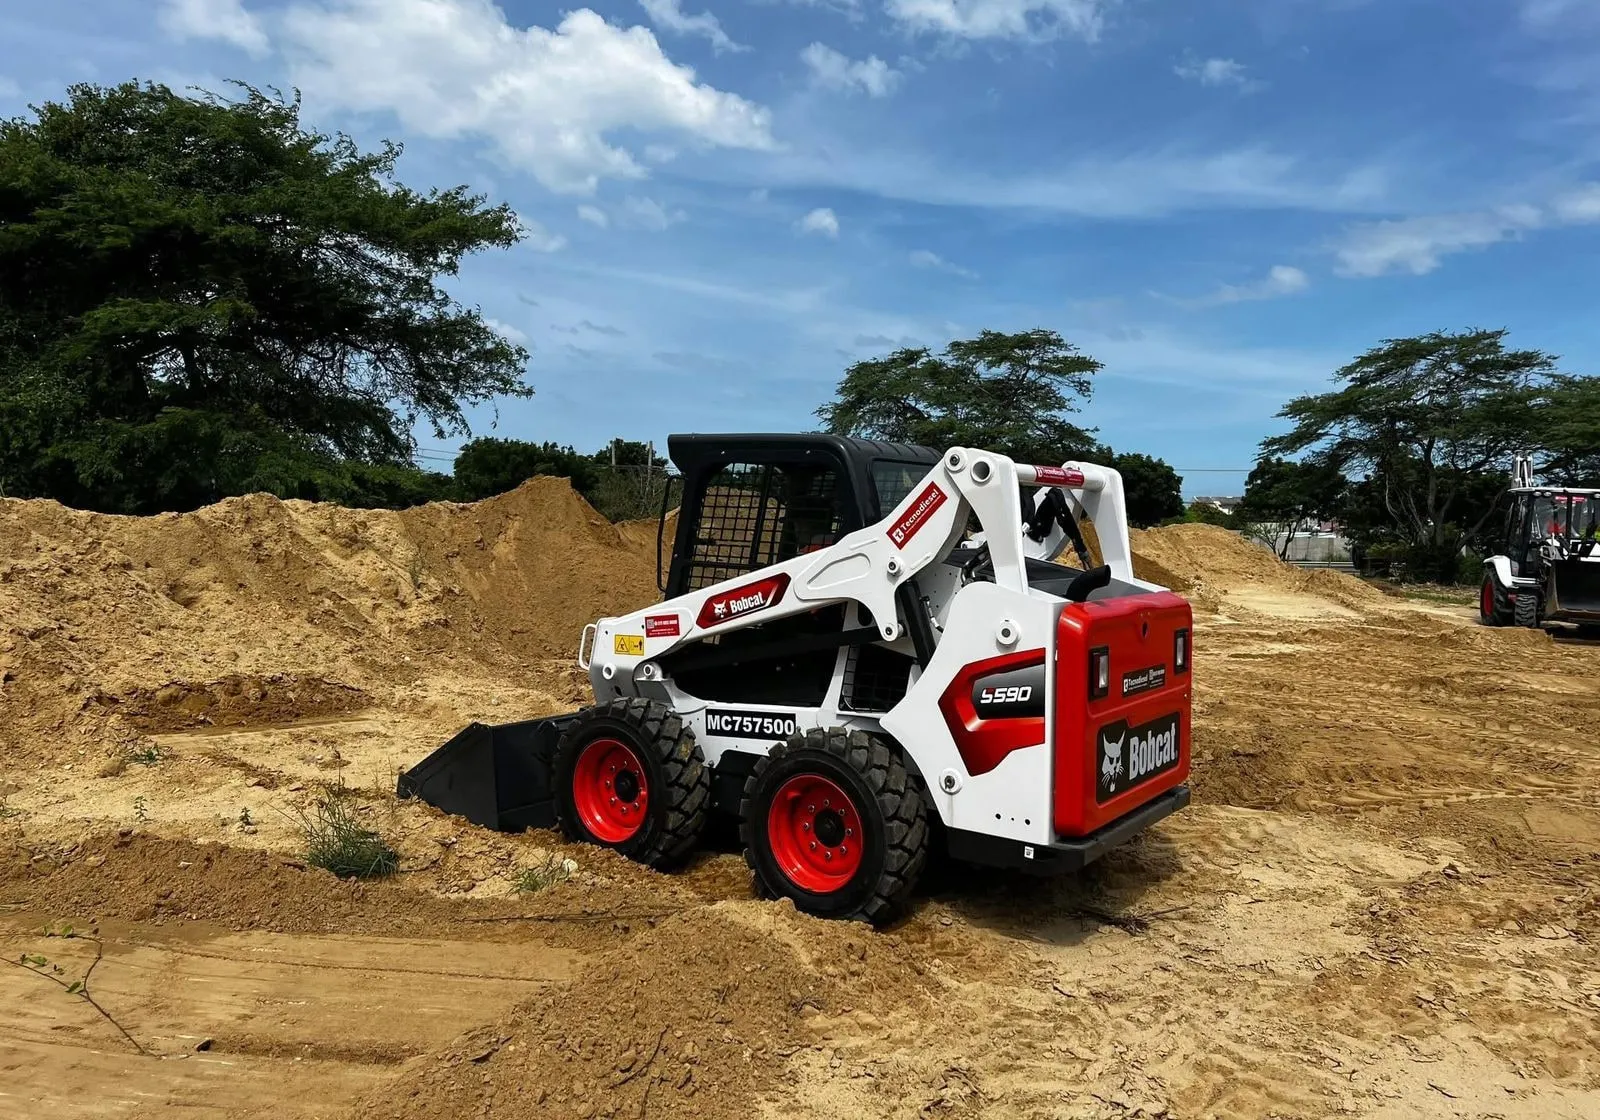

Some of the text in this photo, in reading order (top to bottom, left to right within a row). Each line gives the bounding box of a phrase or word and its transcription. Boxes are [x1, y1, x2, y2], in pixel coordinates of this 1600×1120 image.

[900, 489, 939, 530] Tecnodiesel
[730, 591, 764, 613] Bobcat
[980, 686, 1032, 703] S590
[707, 714, 794, 735] MC757500
[1129, 722, 1176, 780] Bobcat
